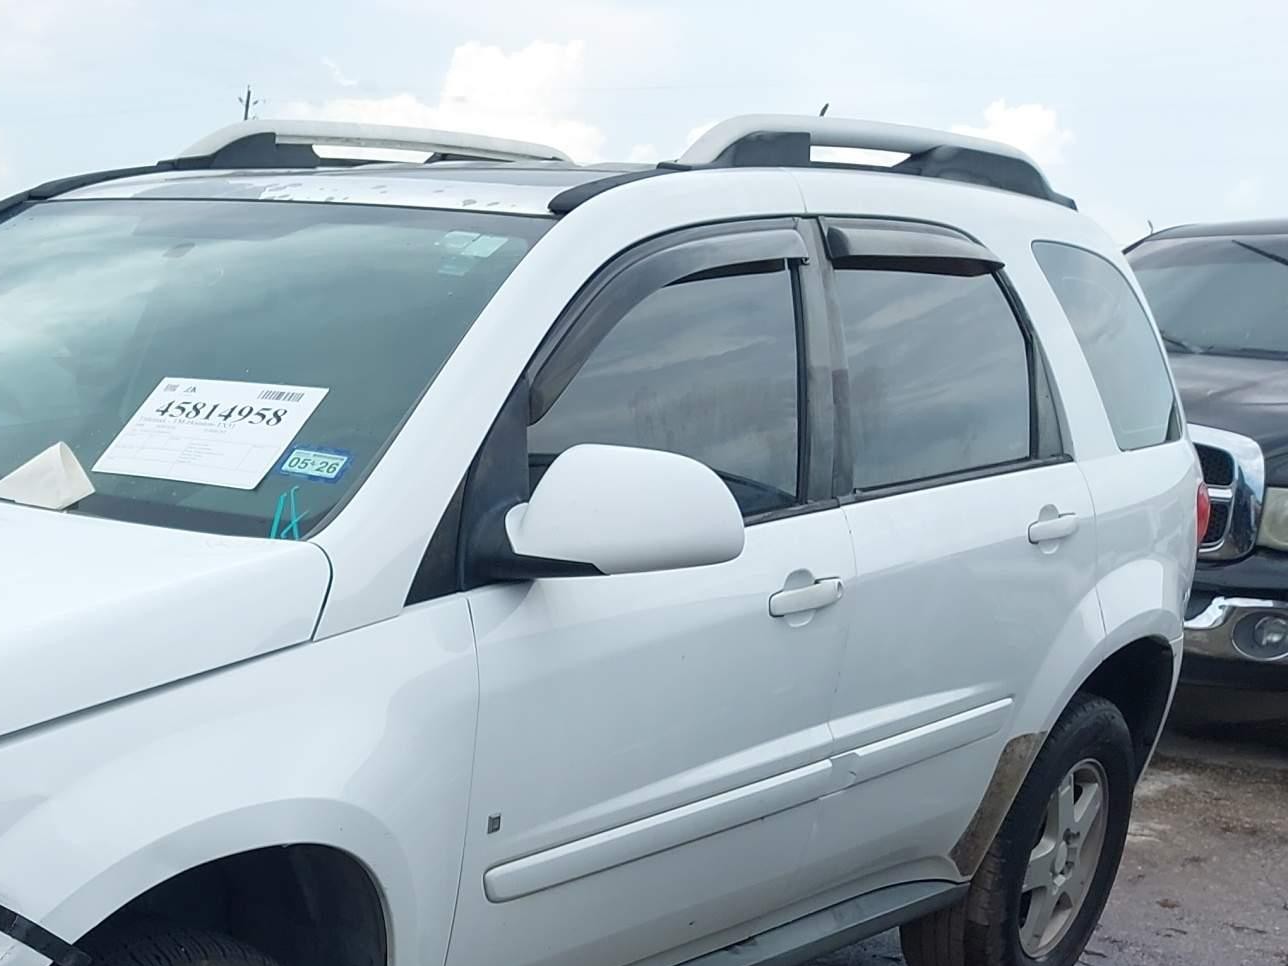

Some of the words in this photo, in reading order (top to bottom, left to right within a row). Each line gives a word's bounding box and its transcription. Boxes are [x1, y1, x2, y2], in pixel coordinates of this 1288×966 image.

[155, 400, 288, 427] 45814958
[288, 457, 312, 470] 05
[315, 461, 340, 474] 26
